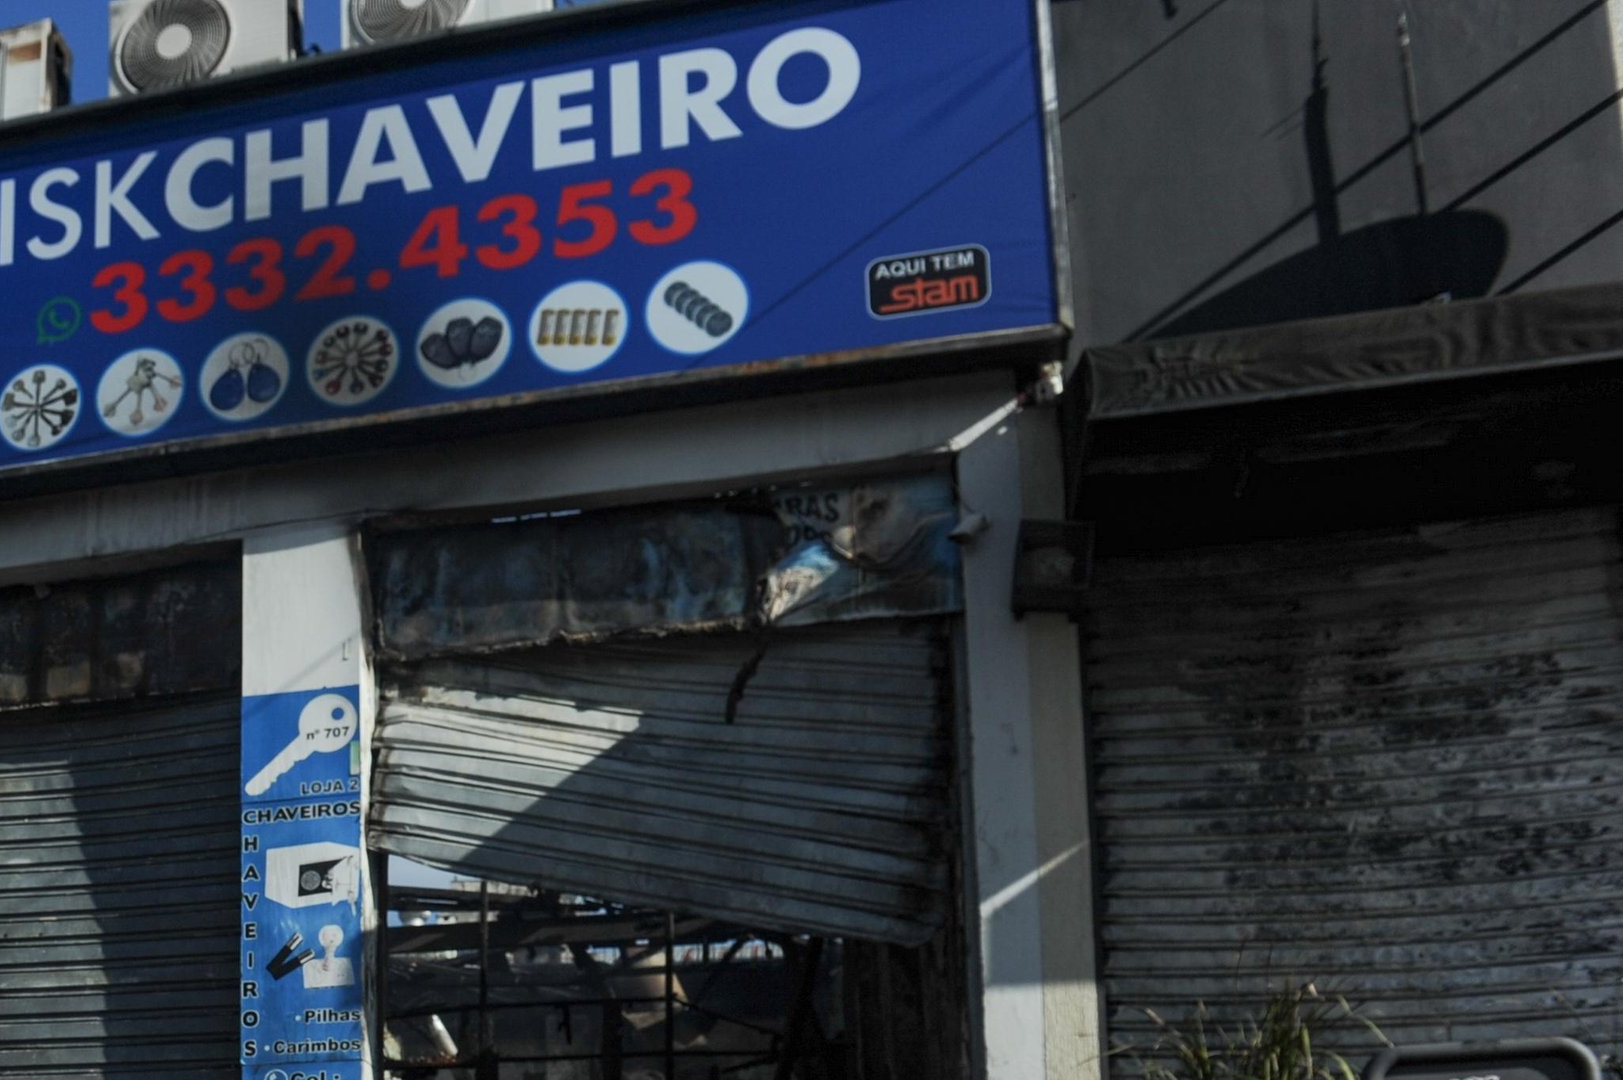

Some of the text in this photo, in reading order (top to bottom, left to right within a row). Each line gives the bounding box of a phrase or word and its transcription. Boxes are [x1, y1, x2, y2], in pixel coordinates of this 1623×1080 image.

[90, 167, 699, 335] 3332.4353
[875, 250, 975, 280] AQUI TEM
[324, 726, 349, 739] 707
[300, 778, 360, 796] LOJA 2
[243, 801, 361, 824] CHAVEIROS
[304, 1009, 361, 1024] Pilhas
[273, 1038, 361, 1055] Carimbos
